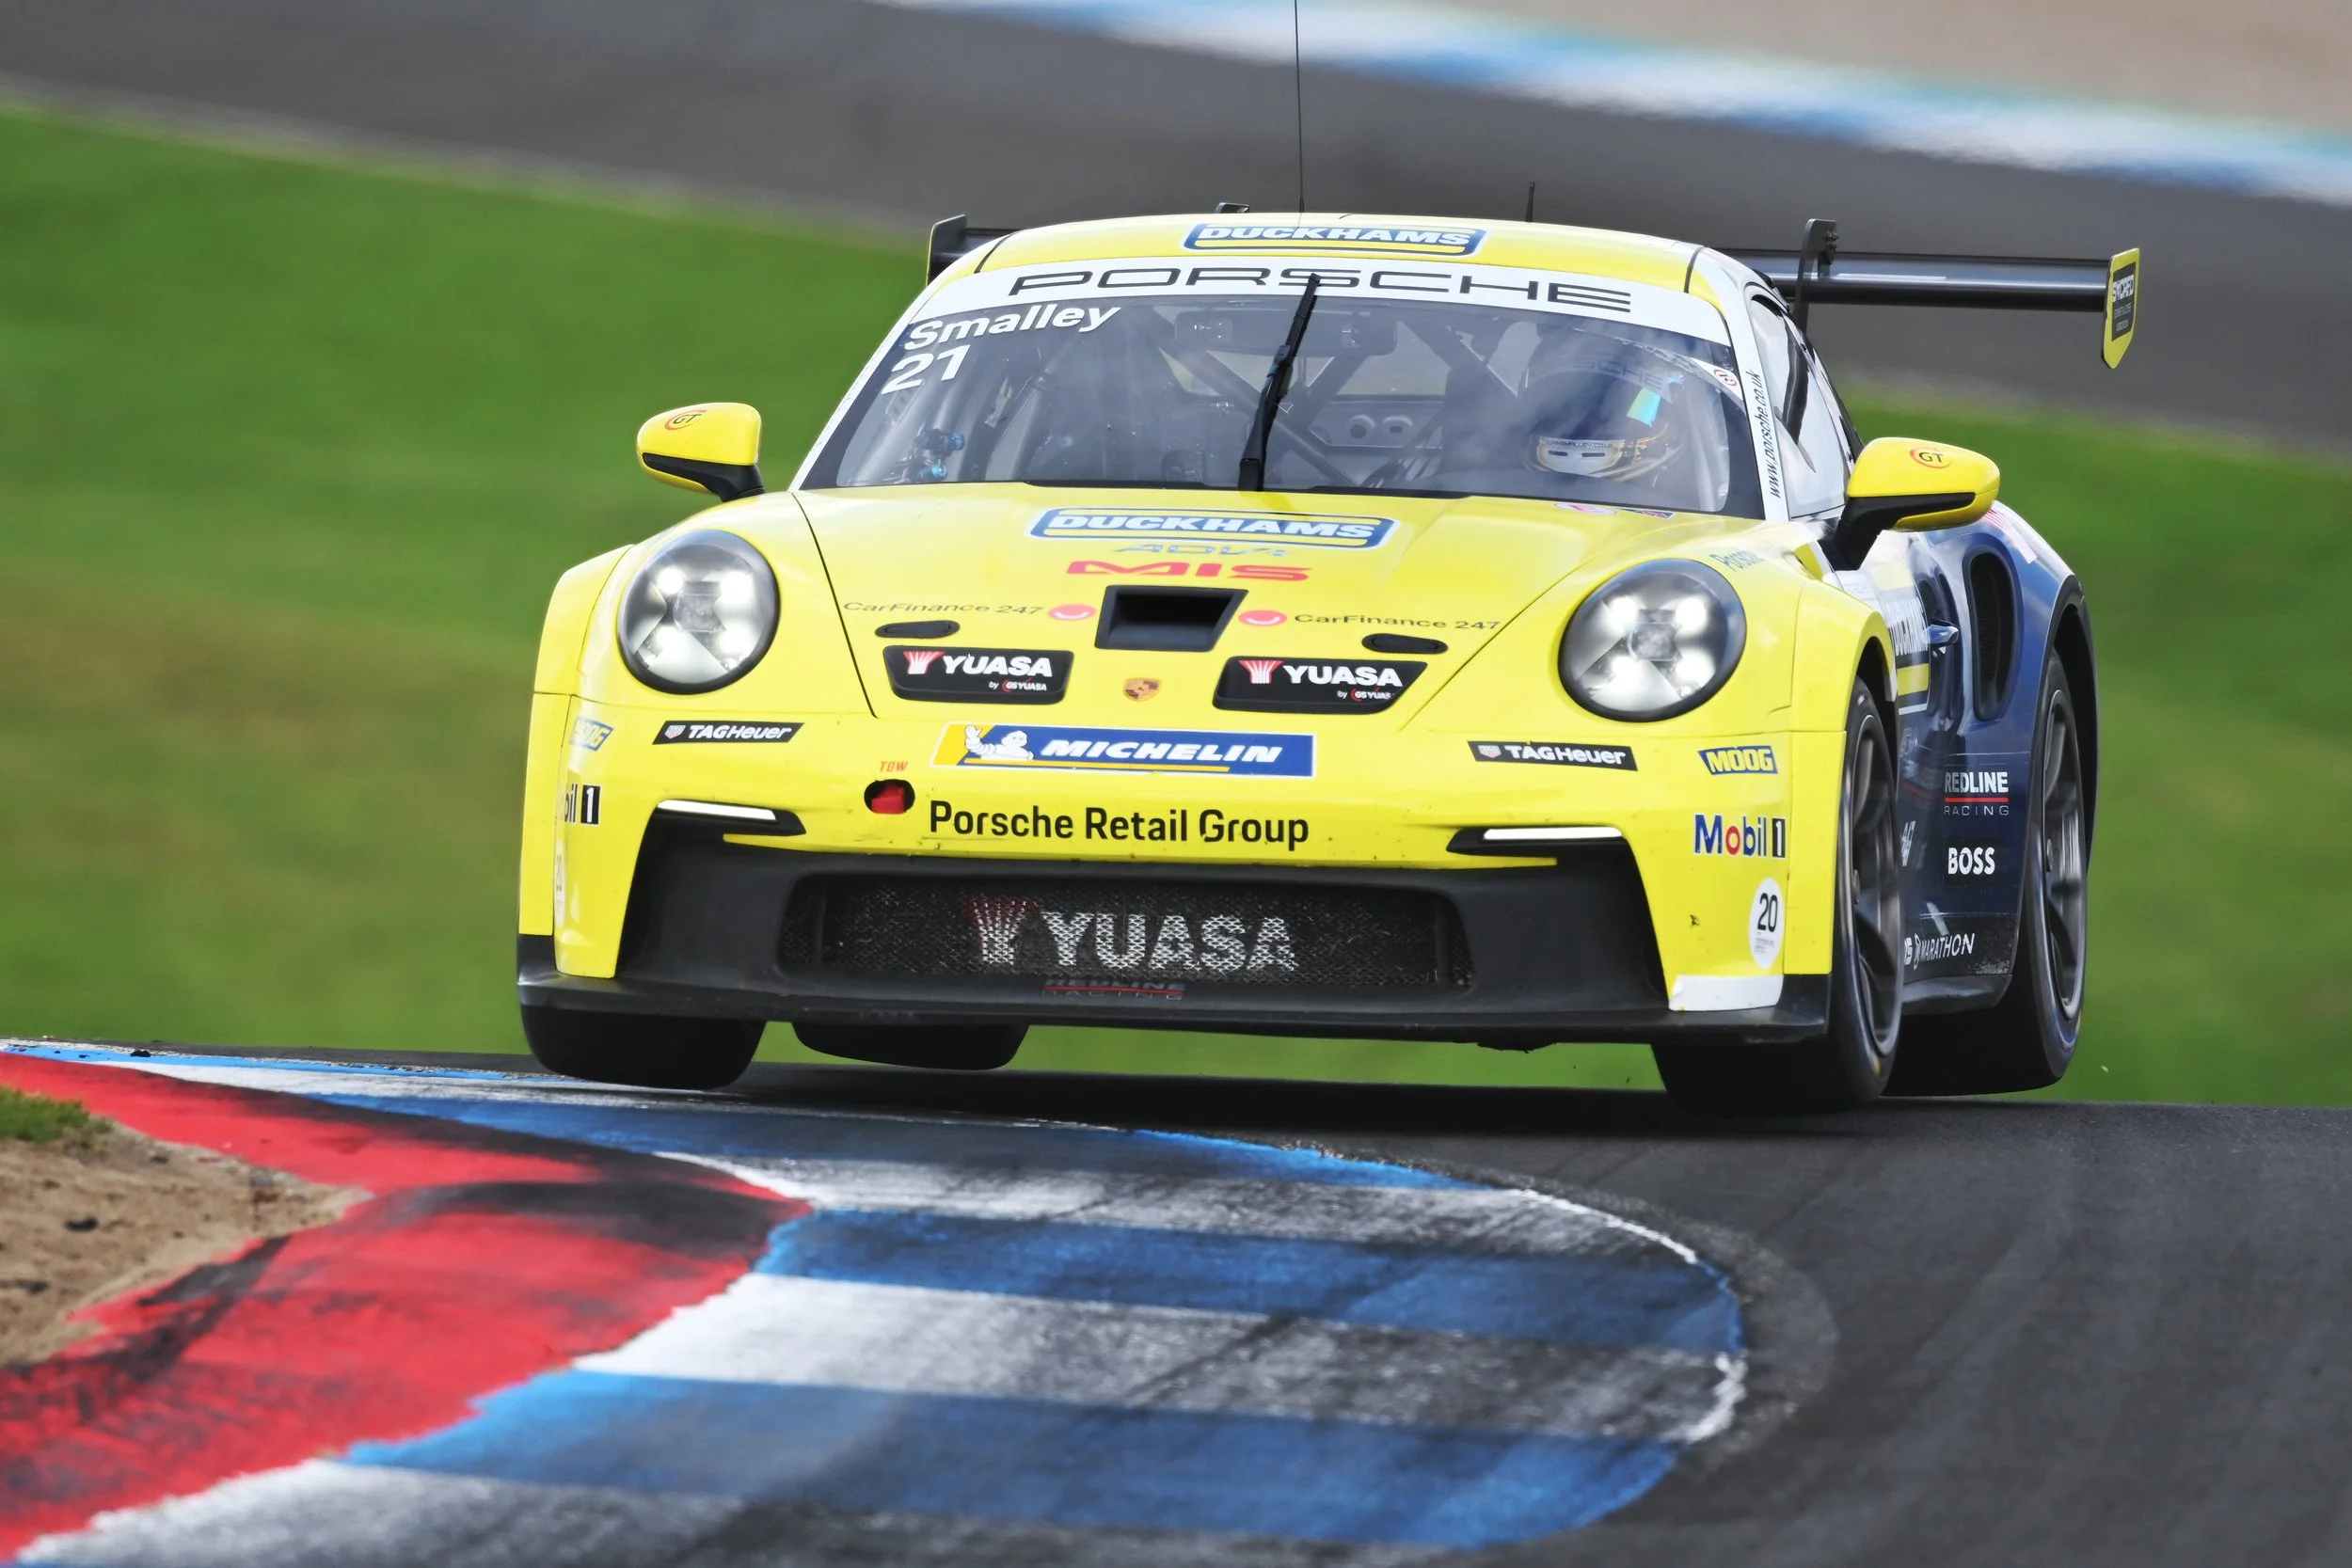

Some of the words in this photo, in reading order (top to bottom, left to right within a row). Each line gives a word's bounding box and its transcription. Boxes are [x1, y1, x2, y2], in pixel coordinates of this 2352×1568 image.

[1196, 227, 1470, 245] DUCKHAMS
[1009, 266, 1631, 313] PORSCHE
[904, 304, 1121, 351] Smalley
[881, 344, 971, 395] 21
[673, 413, 703, 424] GT
[1918, 451, 1944, 463] GT
[1052, 515, 1375, 539] DUCKHAMS
[1066, 561, 1313, 582] MIS
[843, 602, 990, 613] CarFinance
[995, 606, 1045, 614] 247
[1295, 614, 1447, 628] CarFinance
[1454, 620, 1501, 630] 247
[943, 656, 1053, 677] YUASA
[1283, 665, 1403, 687] YUASA
[988, 681, 999, 690] by
[1337, 690, 1348, 700] by
[1041, 739, 1283, 764] MICHELIN
[1706, 749, 1777, 771] MOOG
[880, 760, 909, 772] TOW
[1945, 771, 2009, 794] REDLINE
[1944, 805, 2010, 816] RACING
[930, 800, 1074, 838] Porsche
[1085, 807, 1189, 842] Retail
[1199, 809, 1310, 851] Group
[1693, 814, 1767, 857] Mobil
[1947, 847, 1995, 876] BOSS
[1757, 892, 1778, 932] 20
[1041, 911, 1300, 972] YUASA
